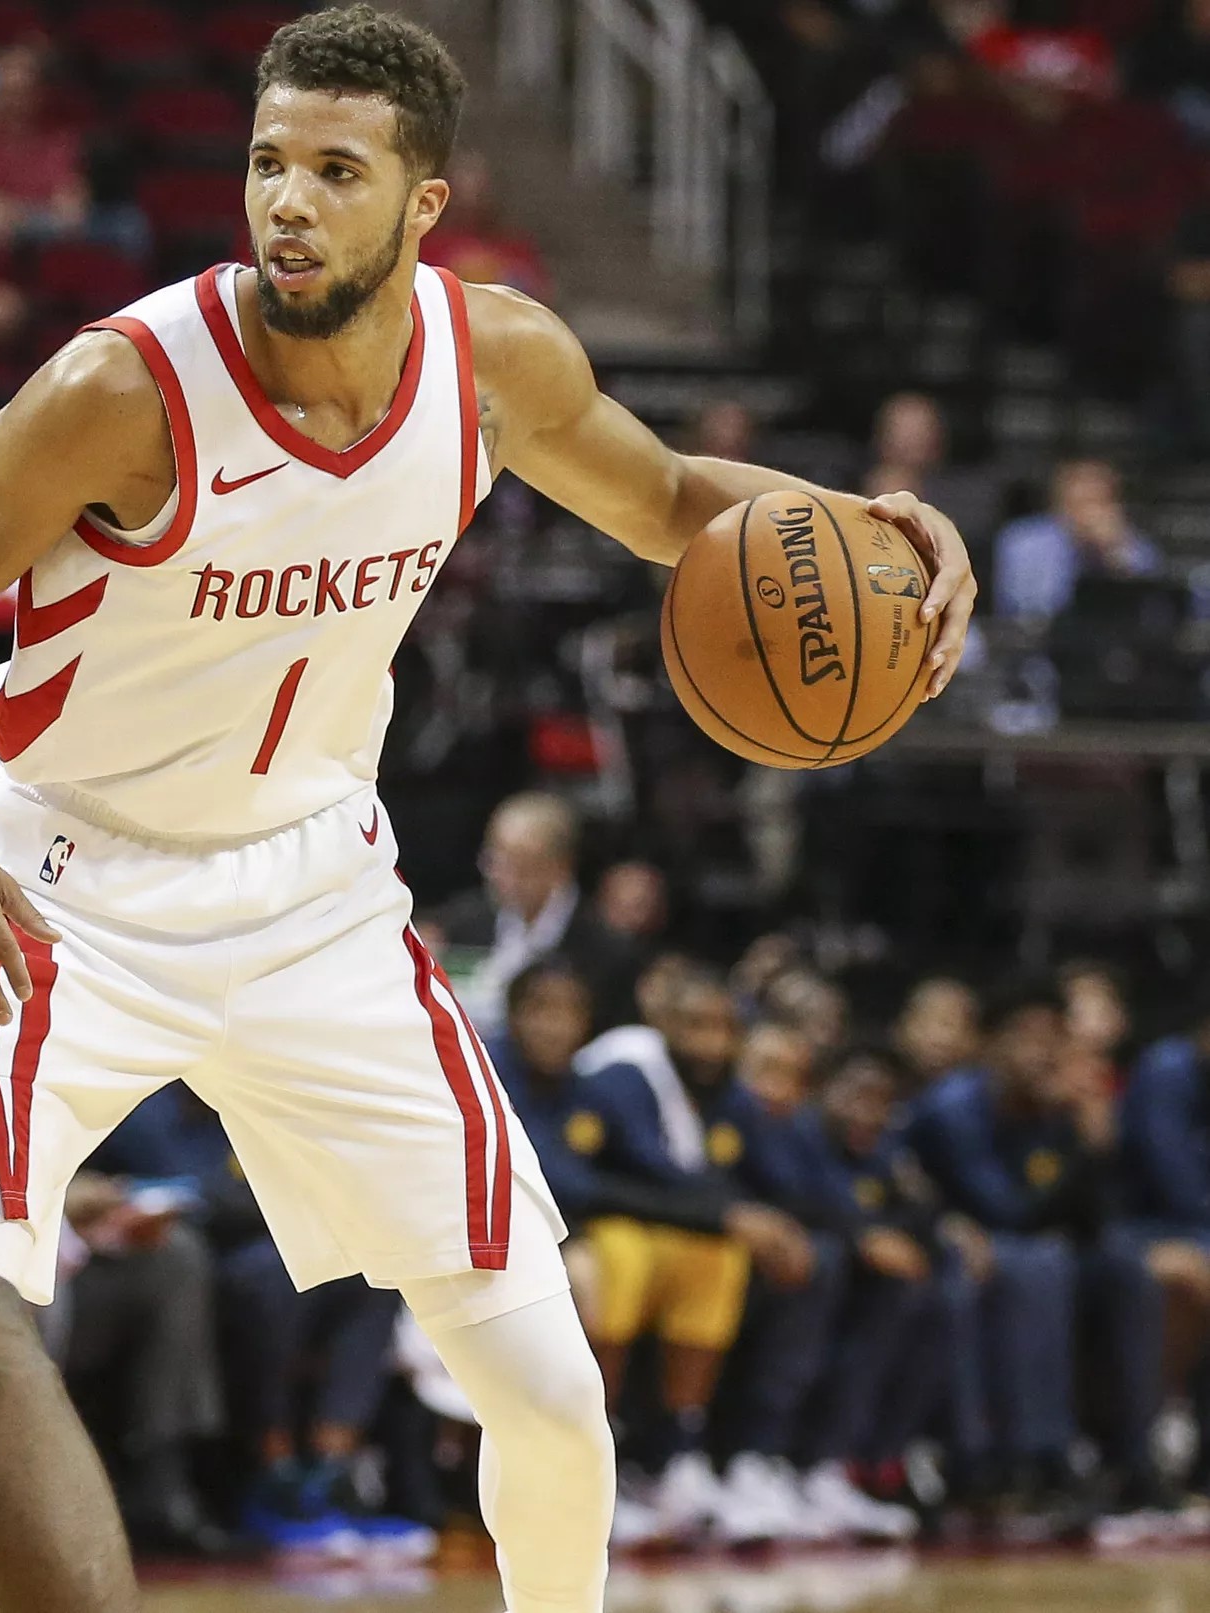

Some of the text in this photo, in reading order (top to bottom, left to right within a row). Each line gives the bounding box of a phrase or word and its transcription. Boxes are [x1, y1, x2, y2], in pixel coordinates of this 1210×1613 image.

[189, 540, 442, 622] ROCKETS
[768, 506, 846, 686] SPALDING
[250, 657, 309, 775] 1
